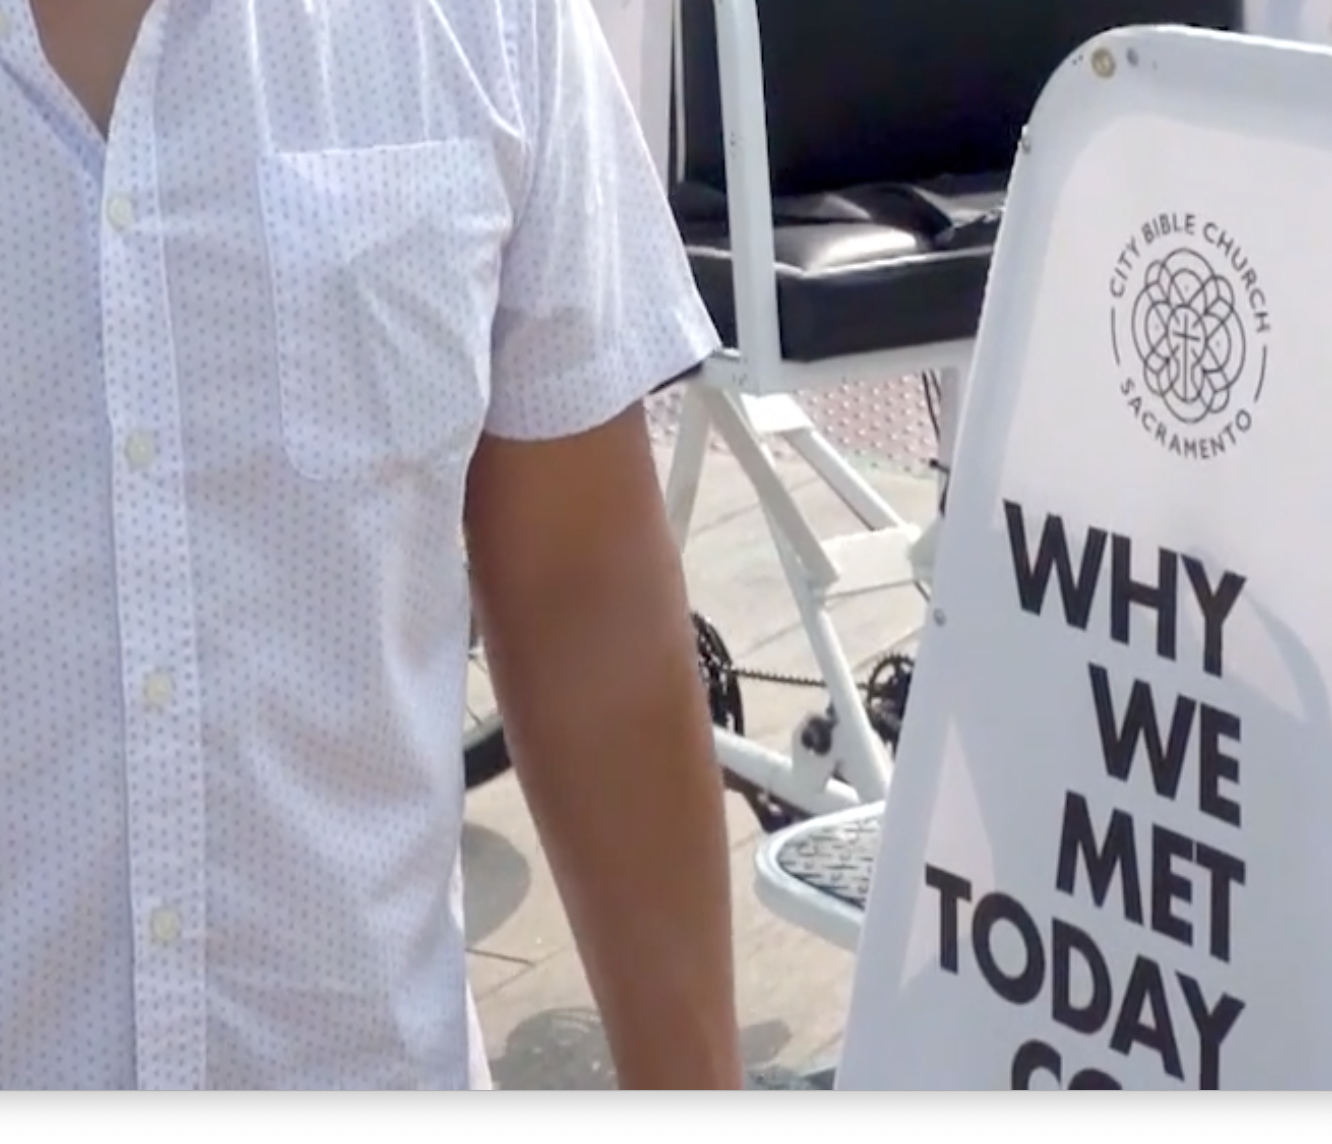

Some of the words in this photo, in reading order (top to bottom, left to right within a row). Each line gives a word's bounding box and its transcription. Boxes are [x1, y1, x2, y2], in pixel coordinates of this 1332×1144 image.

[1110, 236, 1141, 299] CITY
[1141, 213, 1195, 244] BIBLE
[1203, 222, 1270, 333] CHURCH
[1120, 377, 1253, 460] SACRAMENTO
[1002, 498, 1247, 678] WHY
[1088, 662, 1241, 828] WE
[1056, 789, 1246, 963] MET
[925, 863, 1246, 1090] TODAY
